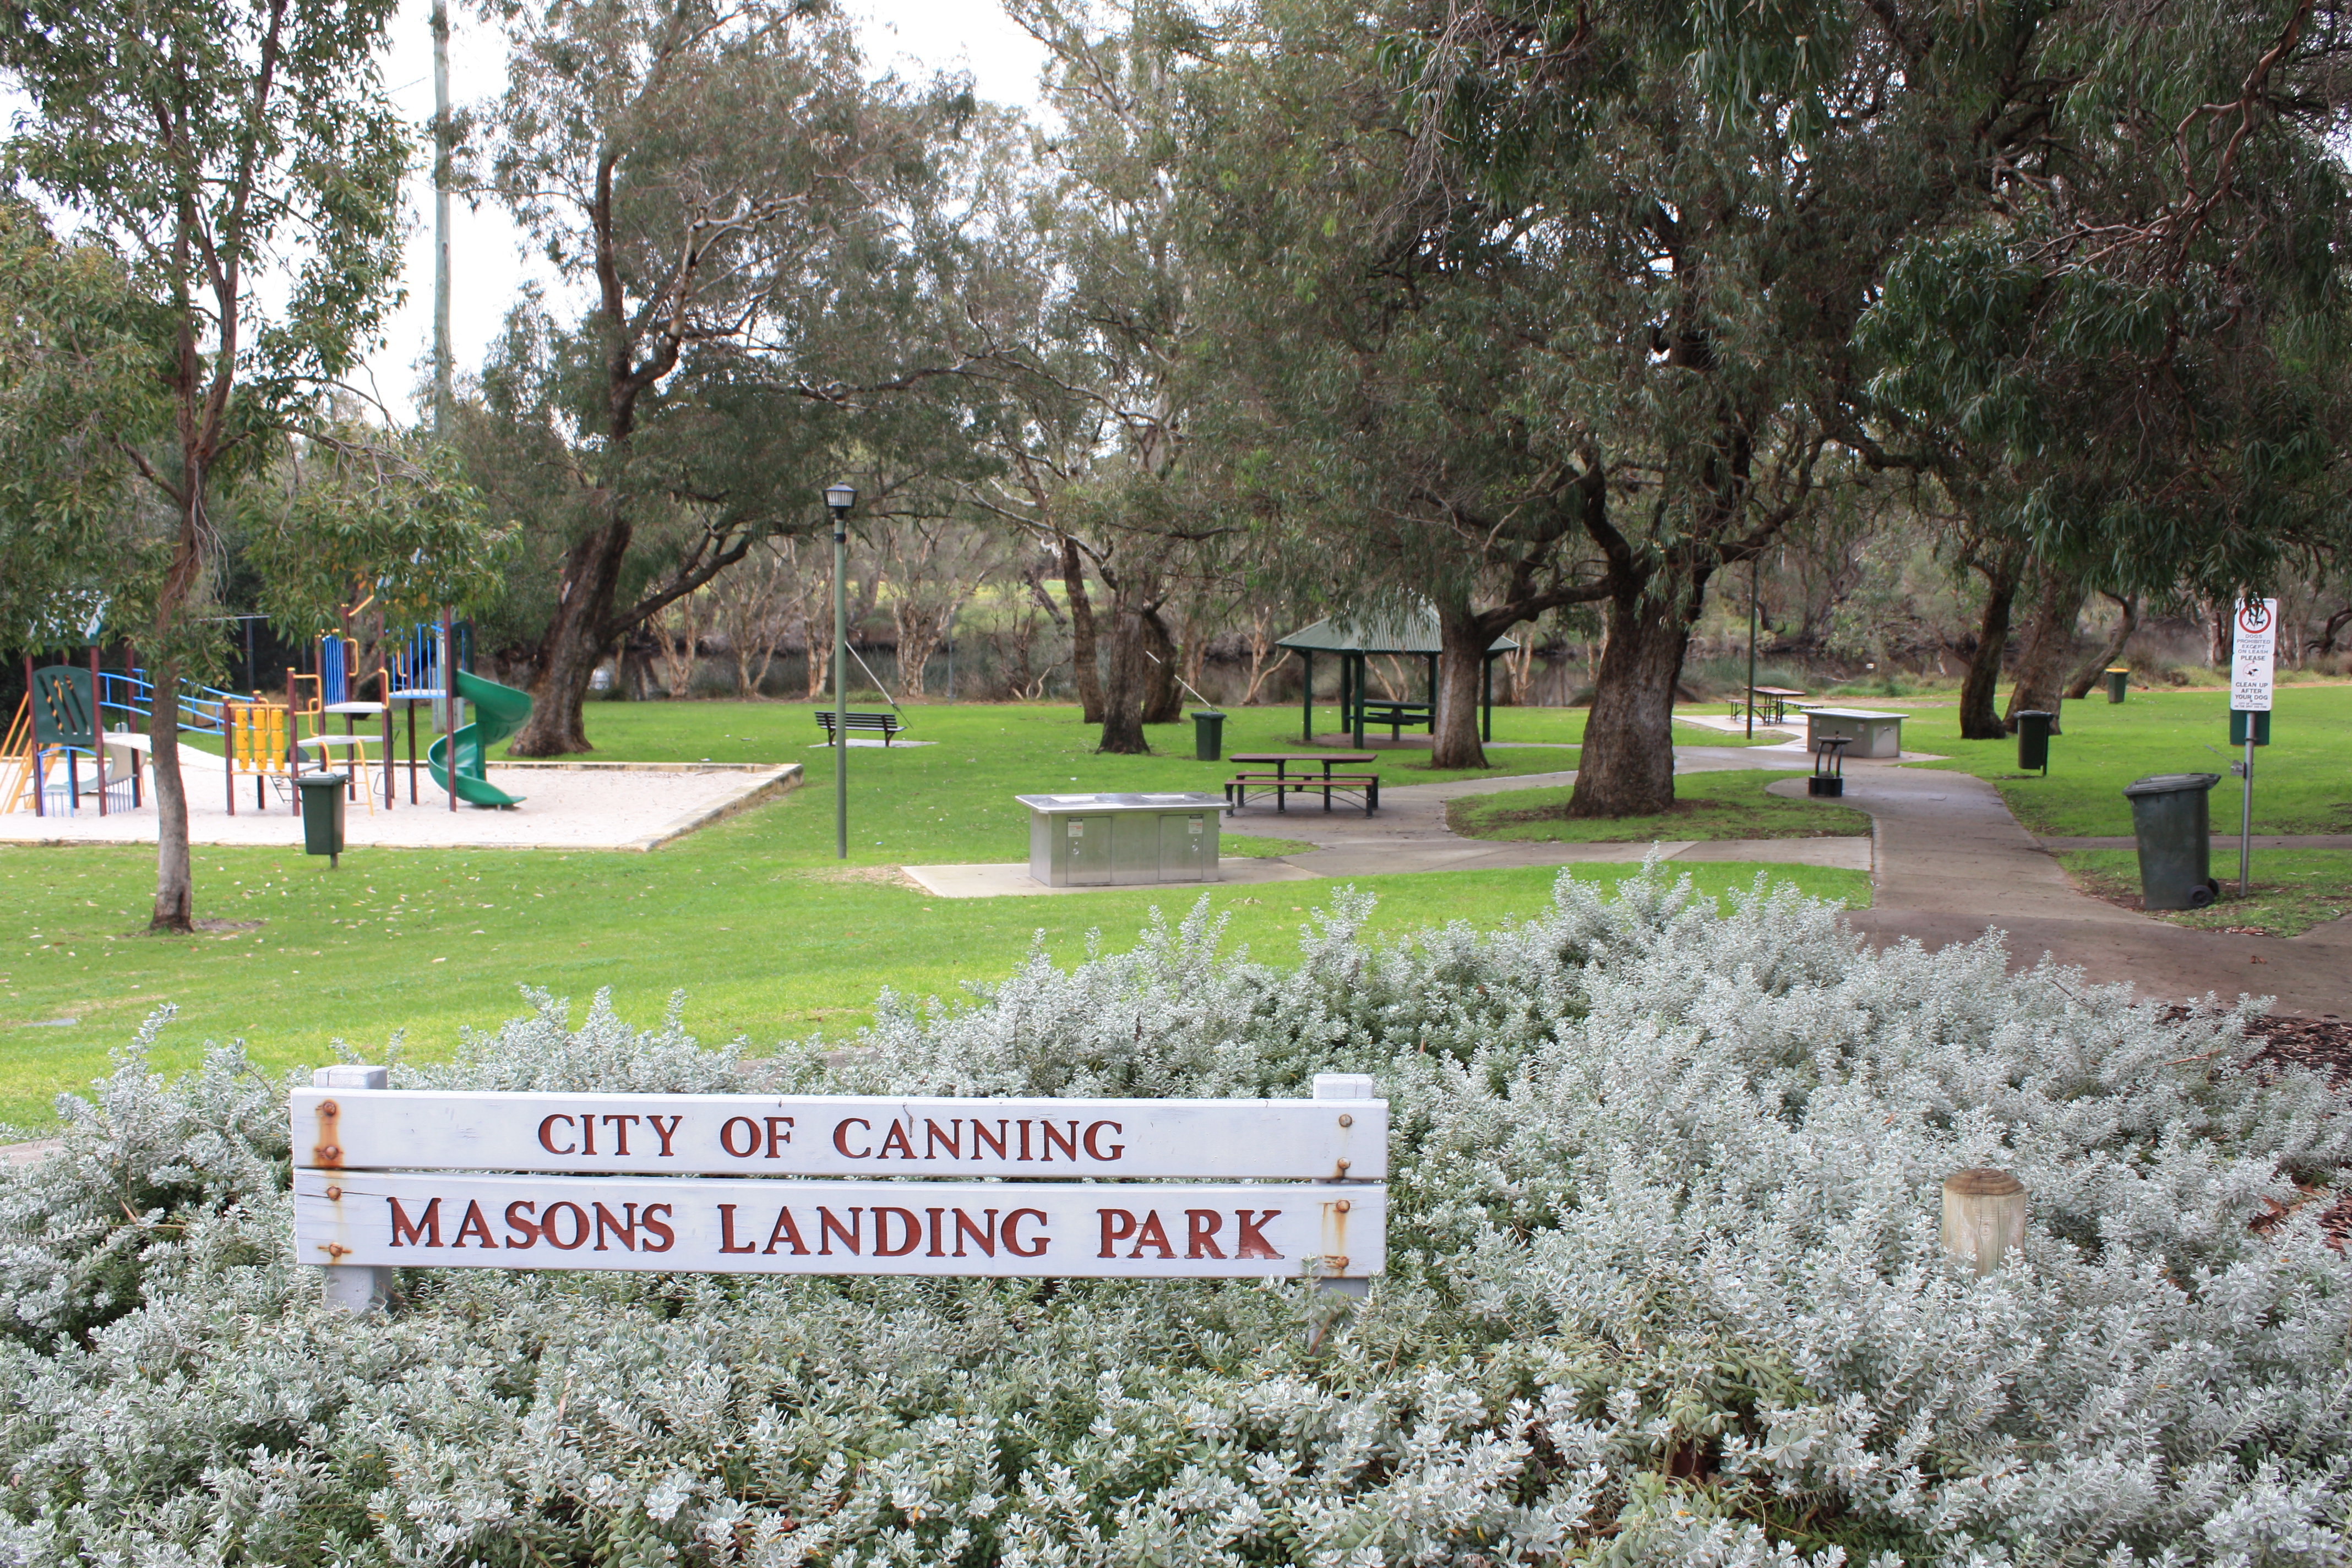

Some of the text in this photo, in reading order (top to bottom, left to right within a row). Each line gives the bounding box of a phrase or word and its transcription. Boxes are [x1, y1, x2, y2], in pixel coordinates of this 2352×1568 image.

[538, 1114, 1125, 1162] CITY OF CANNING
[386, 1196, 1285, 1260] MASONS LANDING PARK
